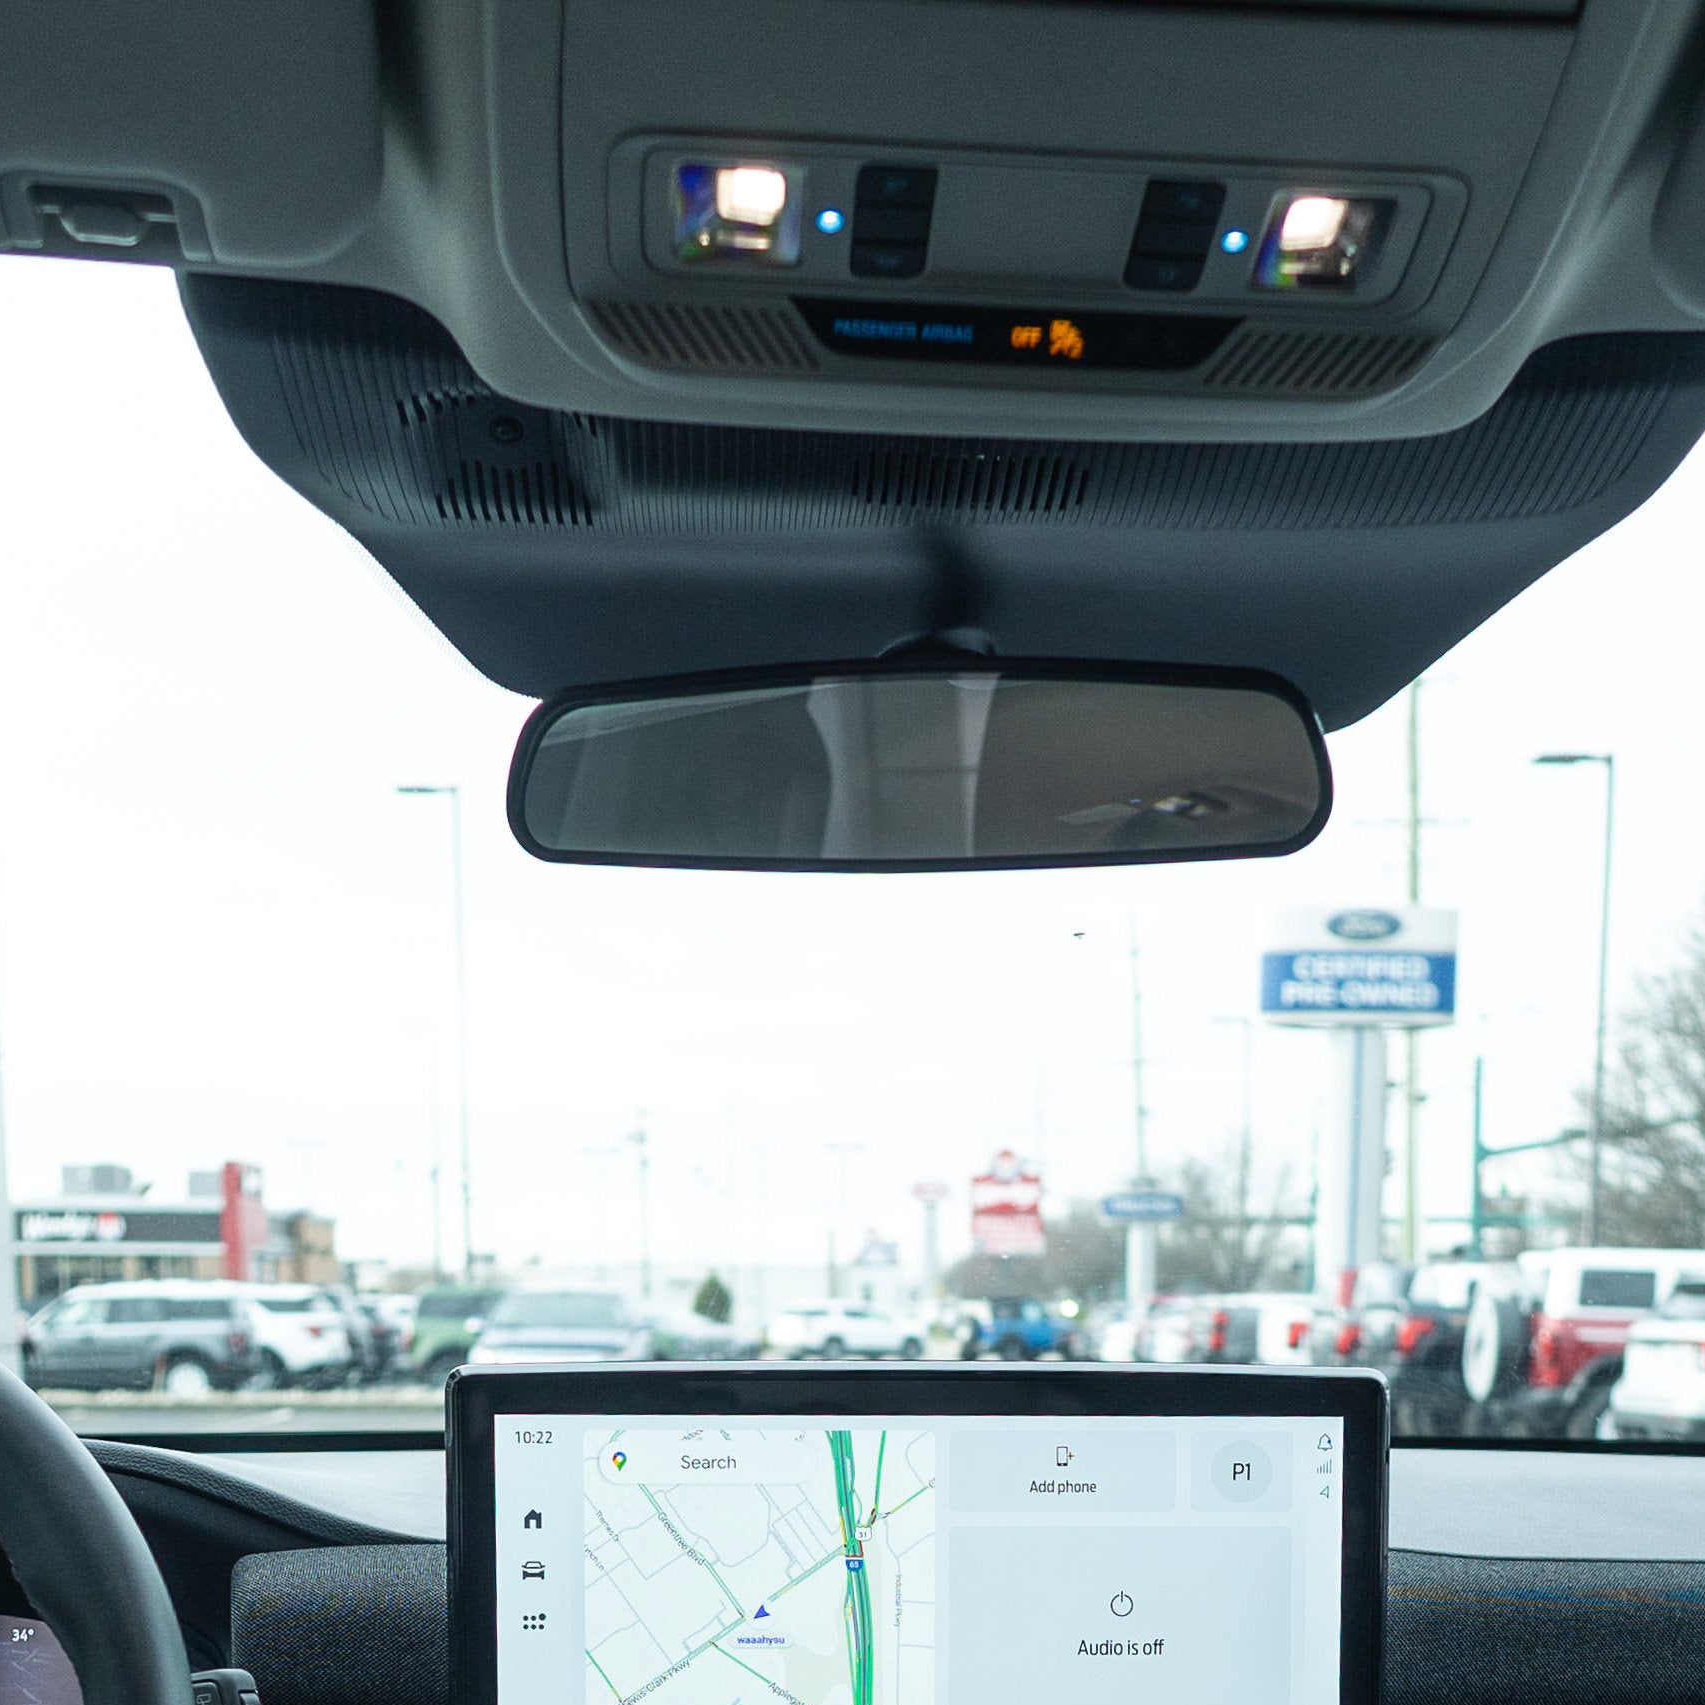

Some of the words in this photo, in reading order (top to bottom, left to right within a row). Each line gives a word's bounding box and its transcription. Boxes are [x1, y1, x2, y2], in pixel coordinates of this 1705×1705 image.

[514, 1430, 554, 1445] 10:22
[680, 1455, 738, 1470] Search
[1231, 1462, 1252, 1482] P1
[1029, 1479, 1054, 1492] Add
[1056, 1479, 1098, 1496] phone
[658, 1512, 689, 1551] Greentree
[686, 1548, 707, 1566] Blvd
[11, 1629, 35, 1642] 34°
[1077, 1638, 1122, 1656] Audio
[1125, 1638, 1138, 1656] is
[1141, 1638, 1166, 1656] off
